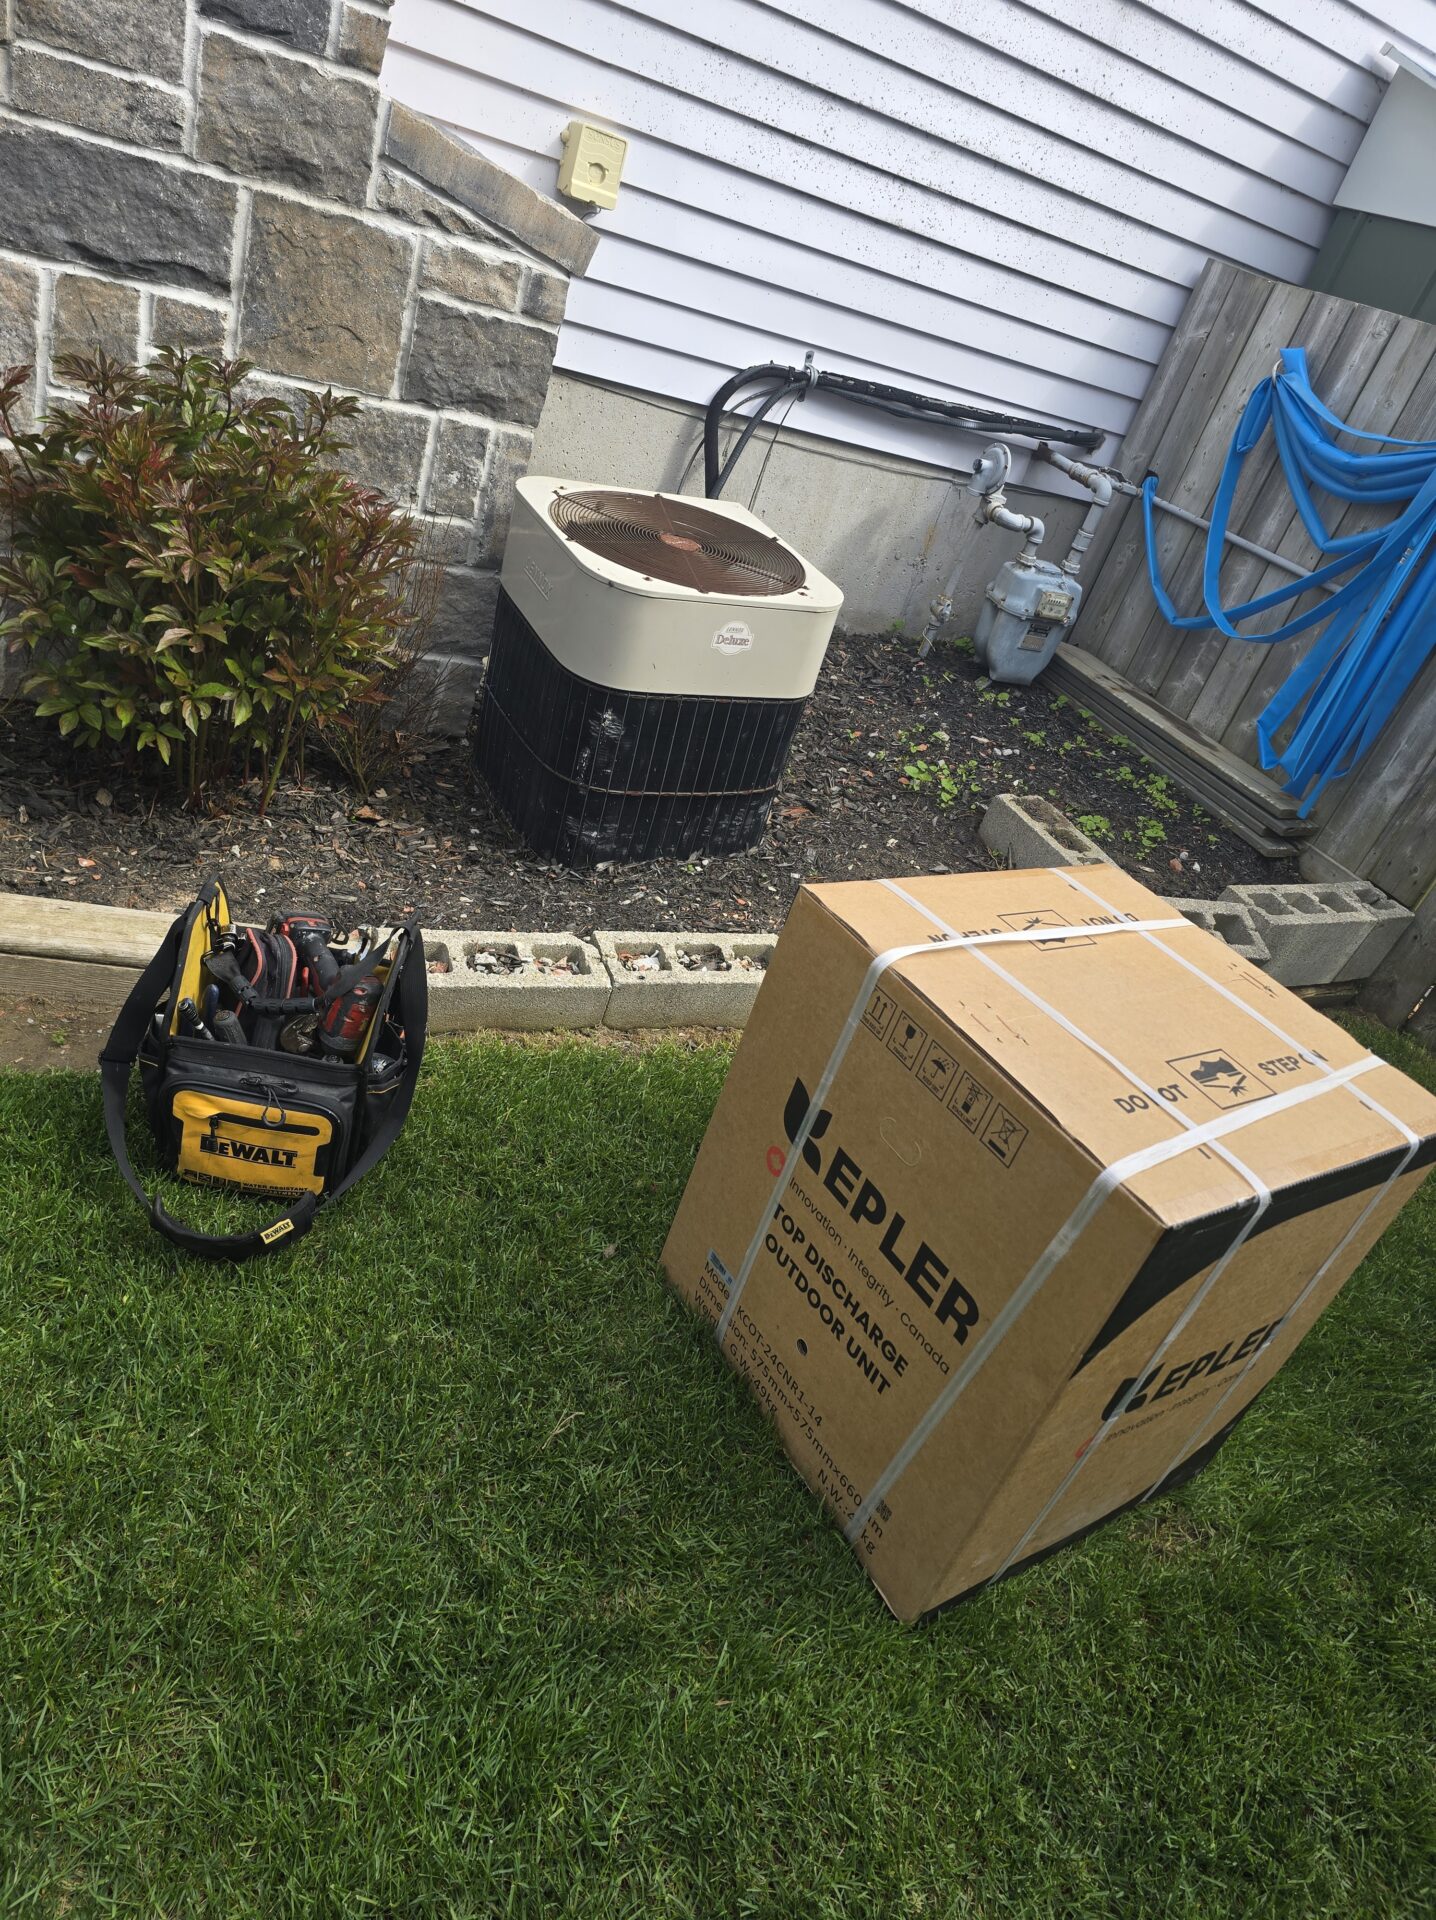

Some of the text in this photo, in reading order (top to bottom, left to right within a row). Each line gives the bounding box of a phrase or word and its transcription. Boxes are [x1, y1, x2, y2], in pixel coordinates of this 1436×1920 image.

[715, 634, 750, 646] Deluxe
[1113, 1093, 1149, 1114] DO
[1257, 1055, 1300, 1077] STEP
[773, 1203, 909, 1378] TOP DISCHARGE
[783, 1076, 980, 1346] KEPLER
[789, 1177, 950, 1375] Innovation Integrity Canada
[736, 1305, 823, 1427] KCOT-24CNR1-14
[765, 1233, 891, 1395] OUTDOOR UNIT
